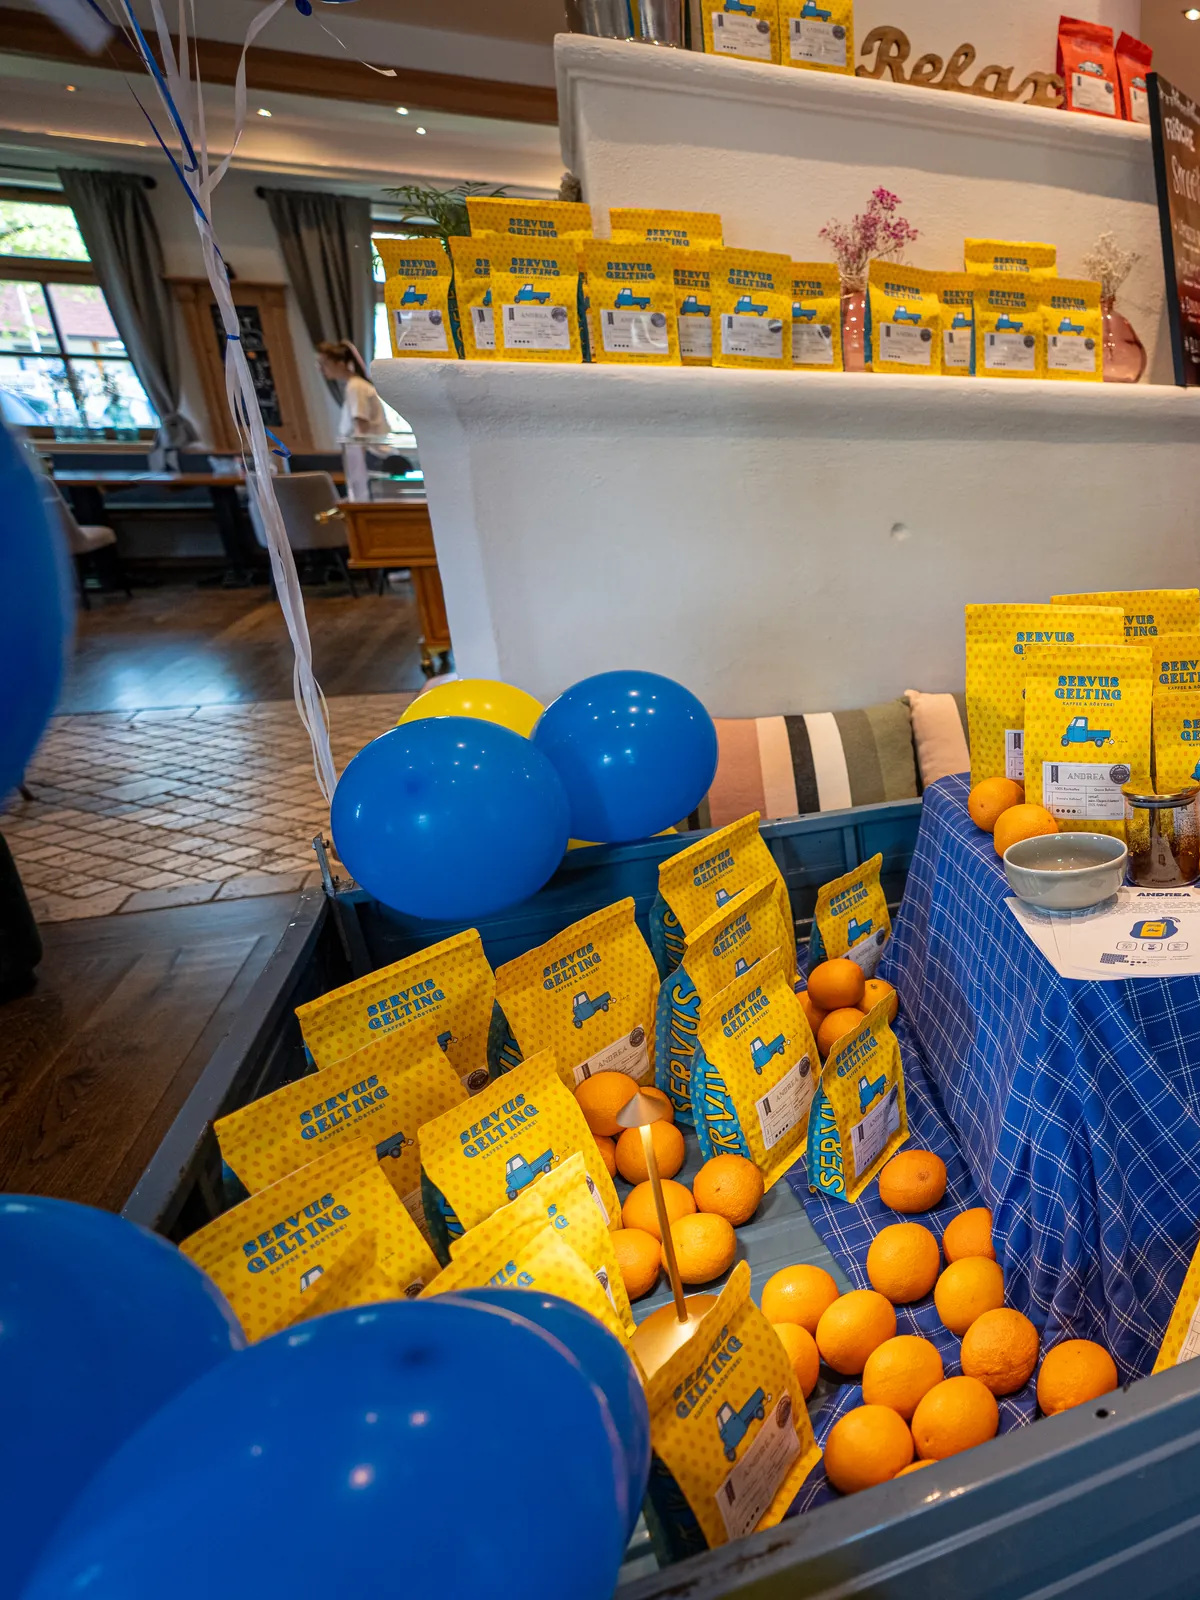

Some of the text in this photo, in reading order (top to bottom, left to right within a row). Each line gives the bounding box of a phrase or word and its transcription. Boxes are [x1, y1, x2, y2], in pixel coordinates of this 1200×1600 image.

[855, 26, 1065, 108] Relax
[508, 218, 554, 229] SERVUS
[508, 227, 558, 238] GELTING
[509, 266, 560, 276] GELTING
[512, 258, 558, 268] SERVUS
[606, 270, 656, 280] GELTING
[607, 262, 652, 271] SERVUS
[674, 269, 710, 279] SERVU
[729, 268, 772, 280] SERVUS
[728, 277, 774, 289] GELTING
[943, 290, 974, 298] SERVU
[989, 290, 1024, 299] SERVUS
[988, 297, 1026, 308] GELTING
[1124, 615, 1154, 624] VUS
[1124, 626, 1158, 636] TING
[1016, 632, 1074, 642] SERVUS
[1054, 688, 1121, 700] GELTING
[1058, 676, 1119, 687] SERVUS
[693, 848, 730, 876] SERVUS
[694, 857, 735, 886] GELTING
[830, 881, 863, 906] SERVUS
[831, 888, 868, 916] GELTING
[543, 943, 594, 978] SERVUS
[543, 952, 602, 990] GELTING
[367, 979, 436, 1017] SERVUS
[368, 989, 446, 1030] GELTING
[721, 986, 762, 1026] SERVUS
[383, 1022, 406, 1034] KAFFEE
[723, 995, 770, 1037] GELTING
[670, 984, 701, 1111] SERVUS
[836, 1026, 870, 1065] SERVUS
[837, 1036, 878, 1077] GELTING
[299, 1074, 380, 1125] SERVUS
[300, 1085, 390, 1141] GELTING
[459, 1093, 526, 1146] SERVUS
[318, 1126, 345, 1142] KAFFEE
[463, 1100, 540, 1158] GELTING
[482, 1141, 504, 1161] KAFFEE
[242, 1193, 336, 1258] SERVUS
[246, 1202, 351, 1274] GELTING
[269, 1254, 299, 1276] KAFFEE
[672, 1324, 729, 1401] SERVUS
[675, 1335, 743, 1419] GELTING
